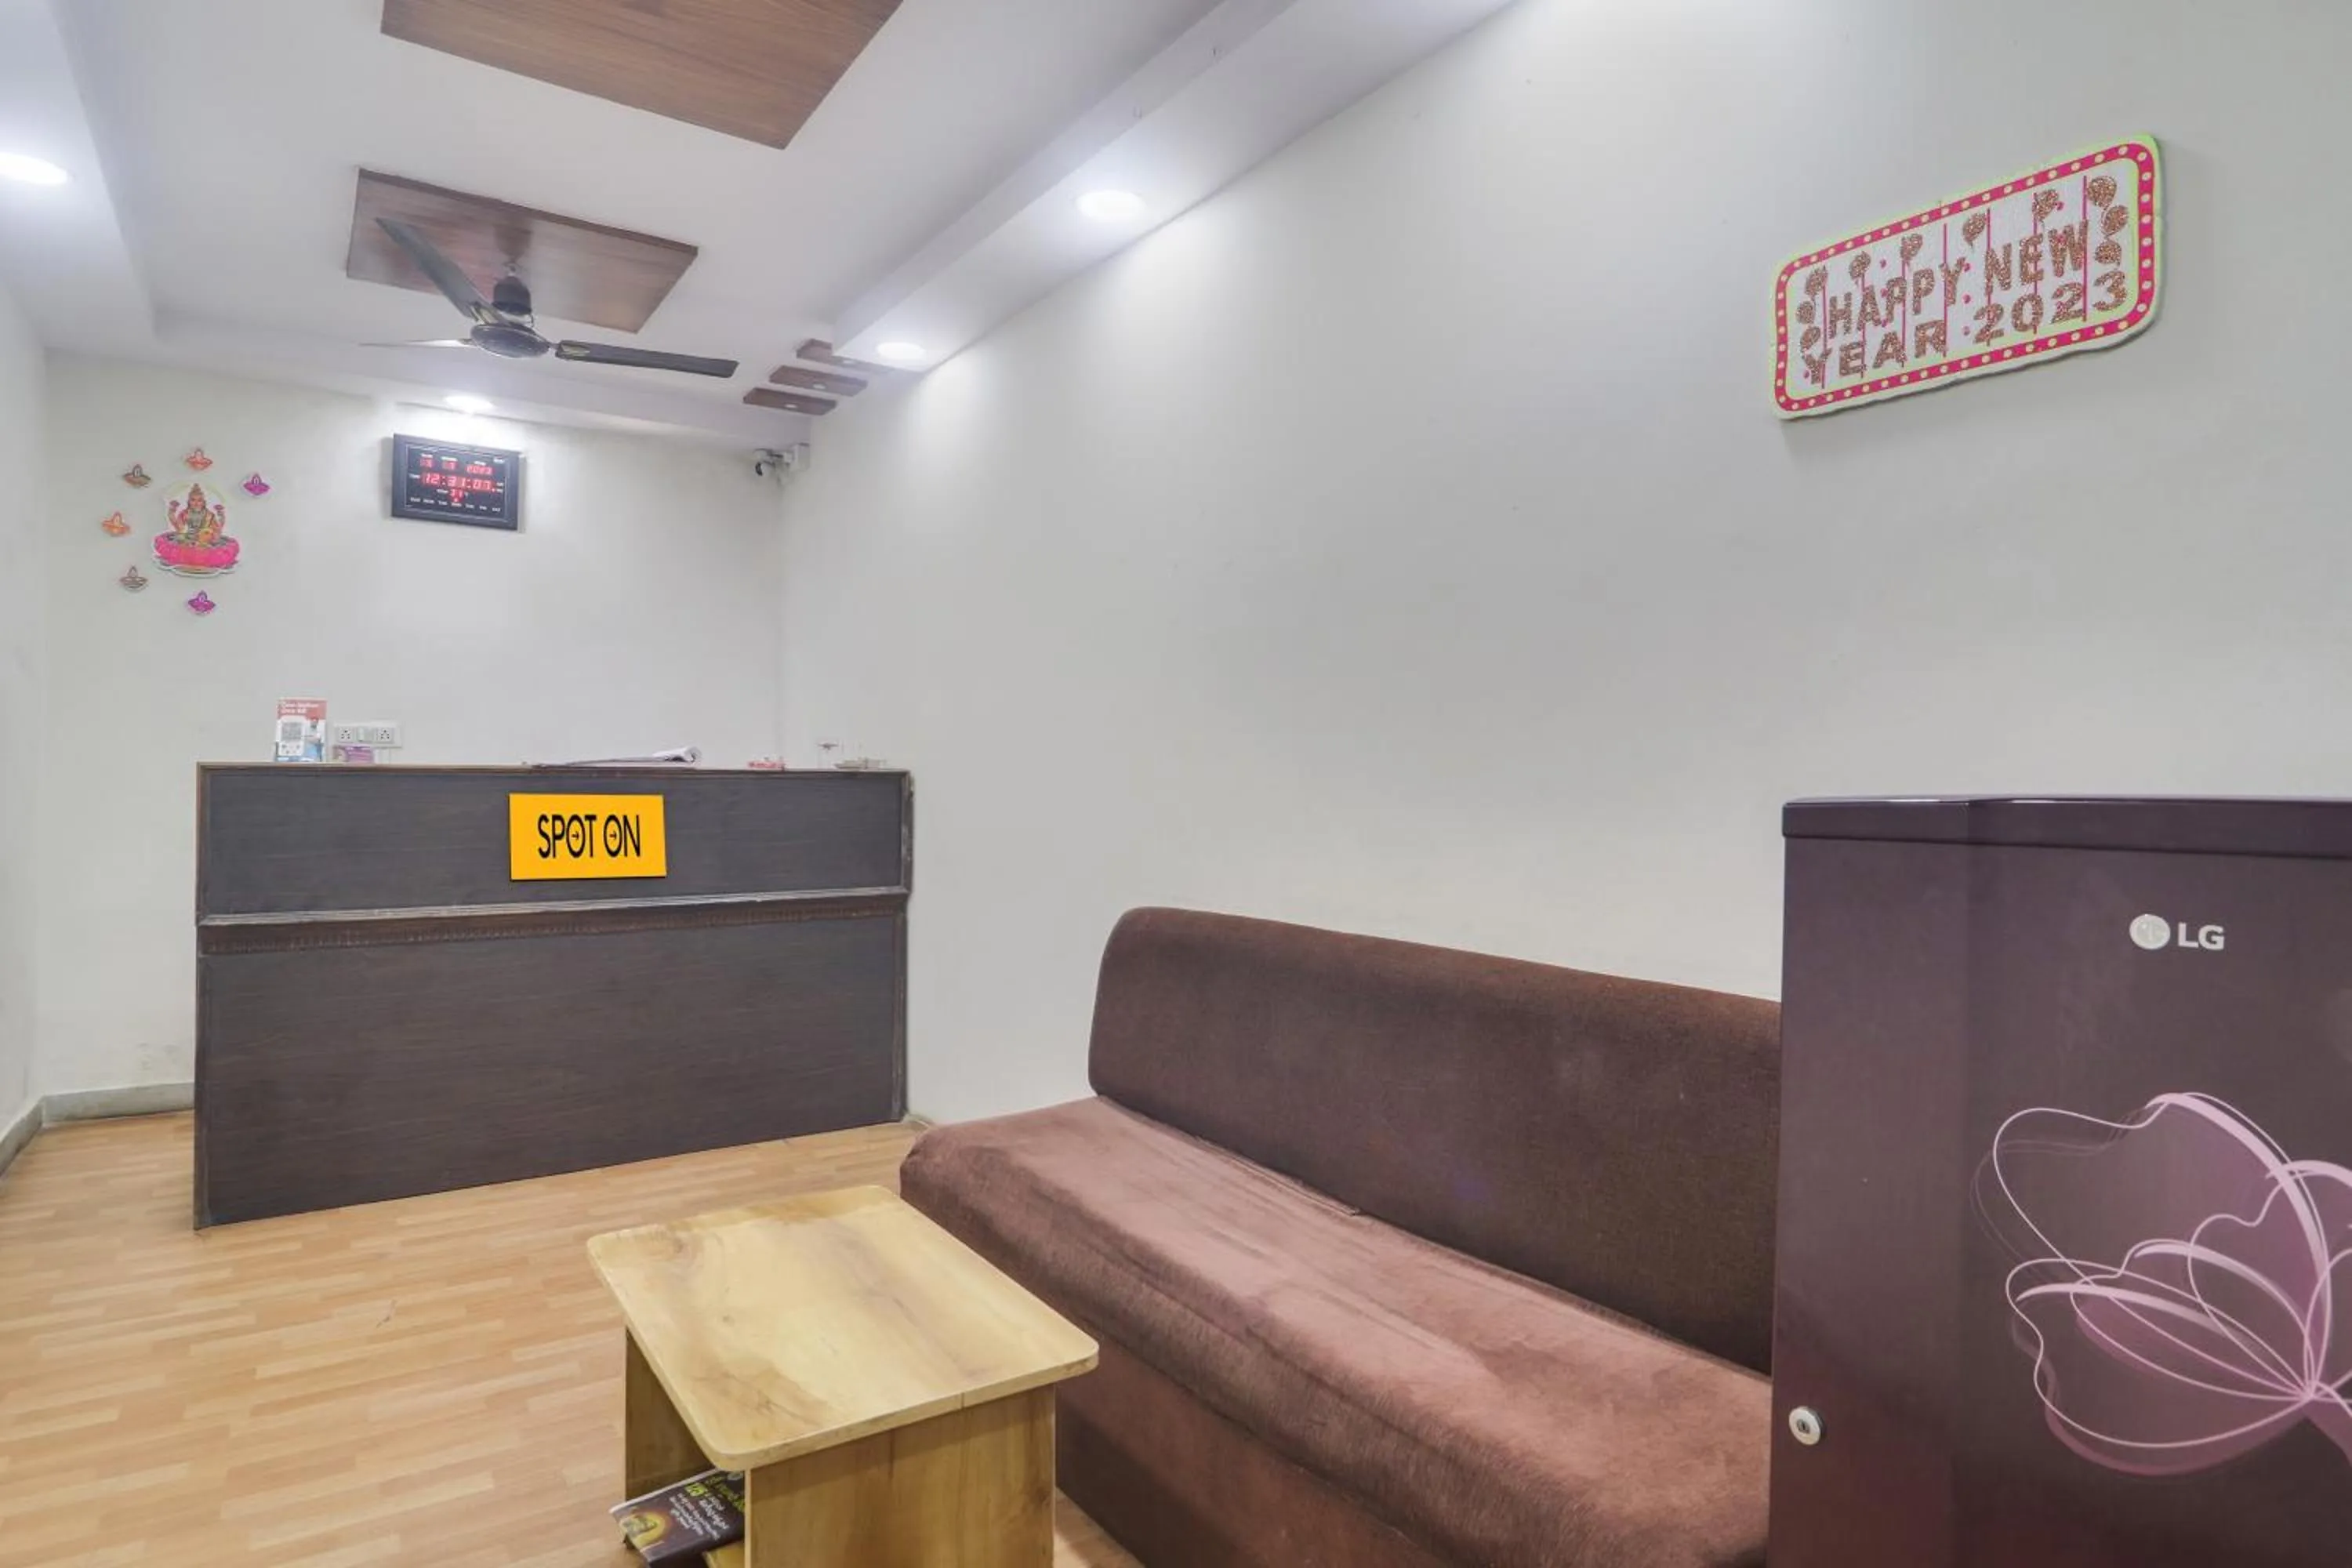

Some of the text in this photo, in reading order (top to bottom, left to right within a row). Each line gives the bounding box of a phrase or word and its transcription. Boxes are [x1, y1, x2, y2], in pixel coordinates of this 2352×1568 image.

[1828, 219, 2089, 339] HAPPY NEW
[1803, 270, 2127, 385] YEAR 2023
[537, 813, 641, 858] SPOT ON
[2178, 922, 2225, 950] LG
